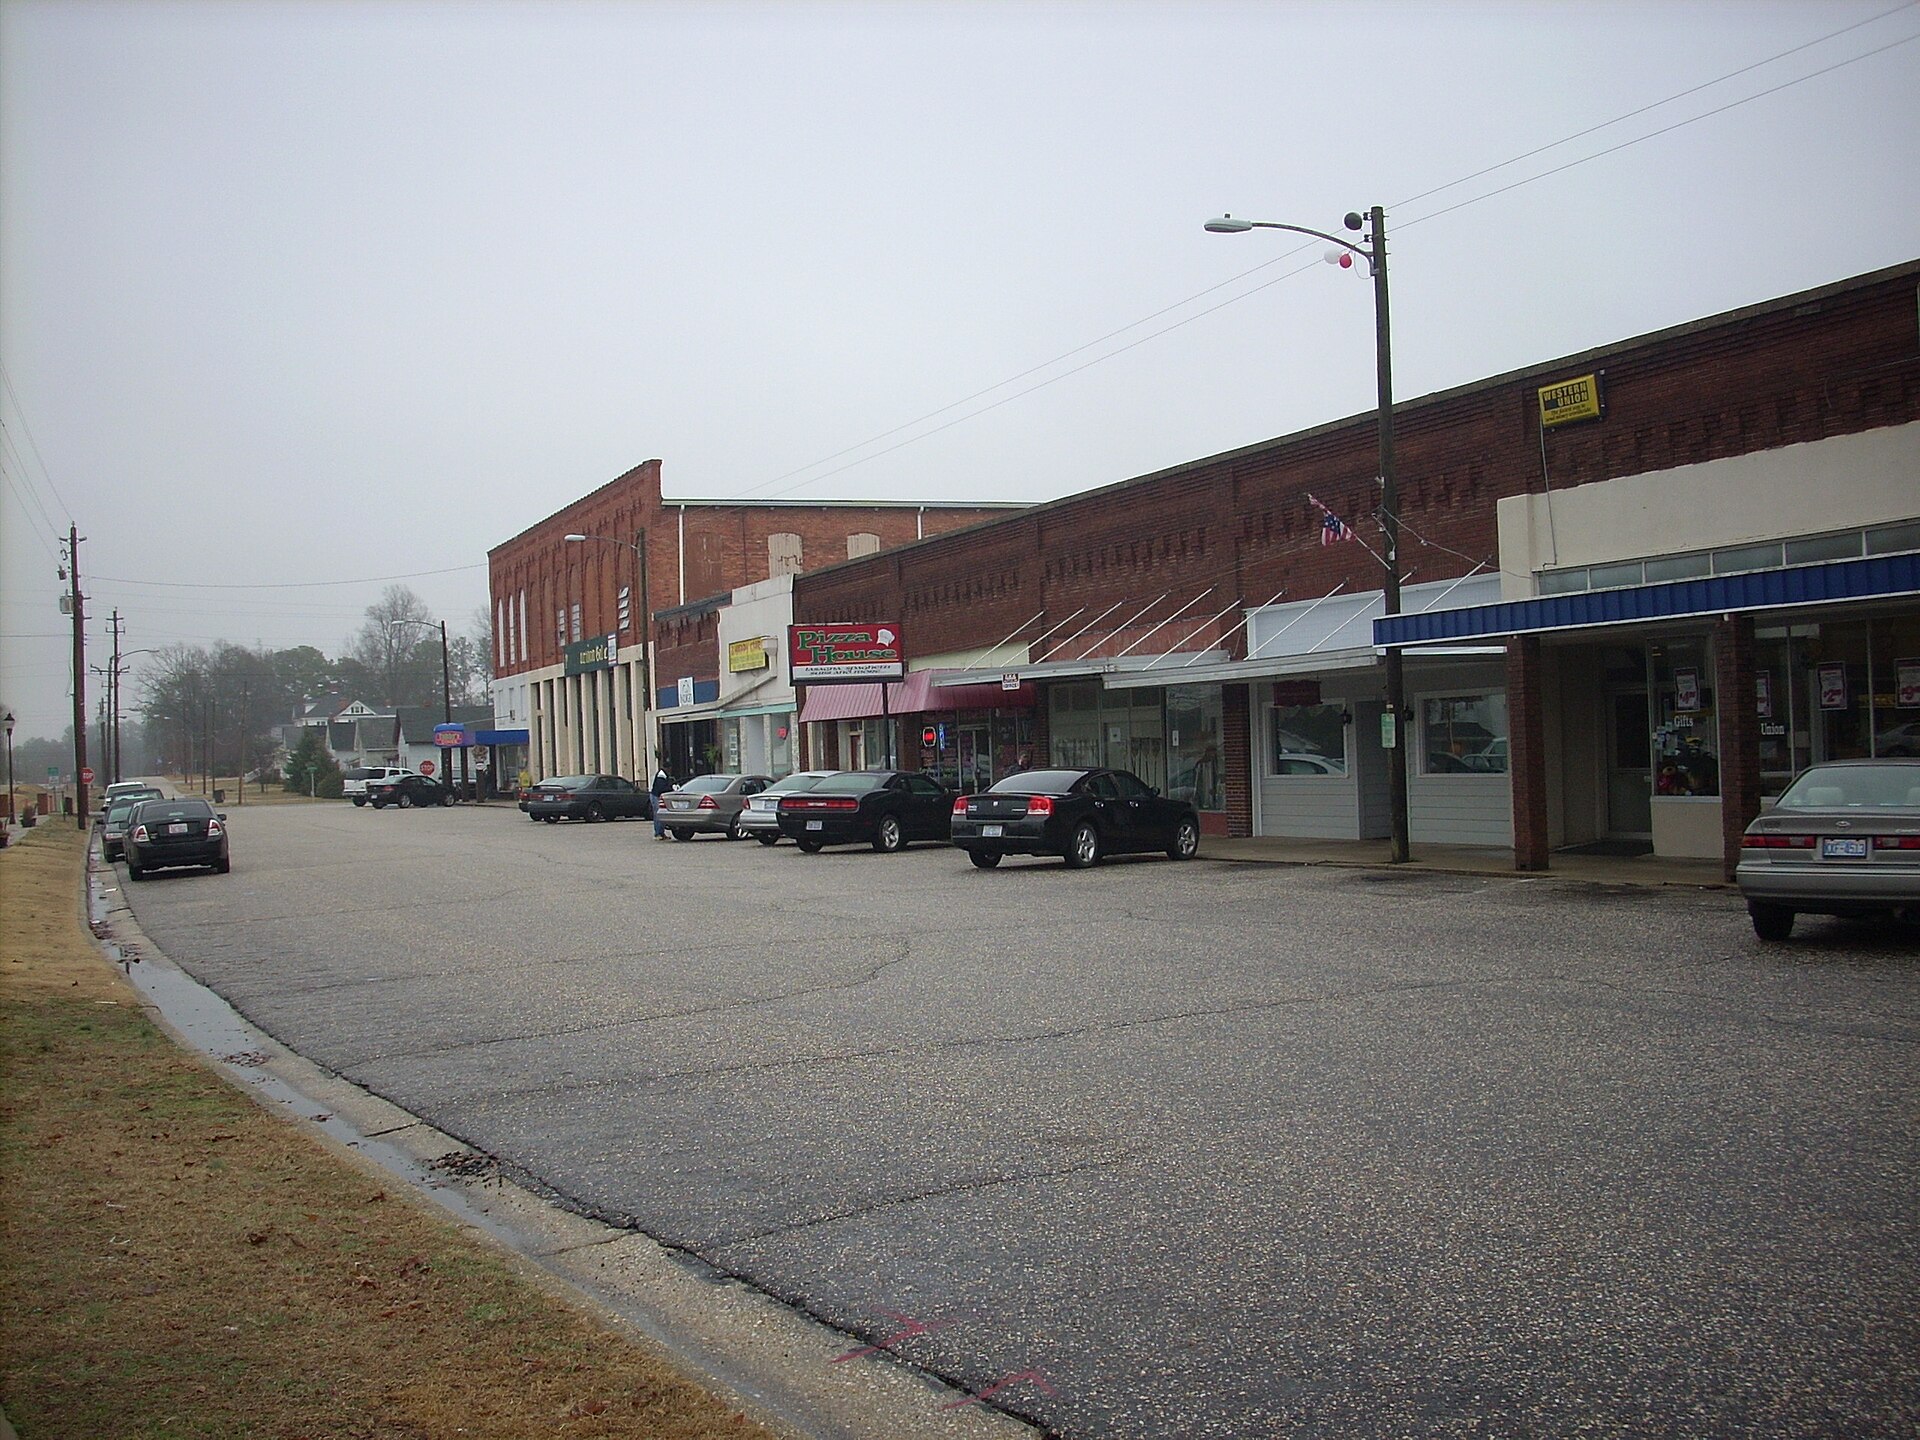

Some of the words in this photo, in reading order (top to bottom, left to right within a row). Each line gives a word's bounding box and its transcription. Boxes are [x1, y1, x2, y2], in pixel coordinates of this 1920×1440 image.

[1543, 382, 1587, 401] WESTERN
[1557, 391, 1588, 407] UNION
[797, 630, 872, 649] Pizza
[810, 645, 897, 665] House
[1674, 715, 1694, 727] Gifts
[1760, 722, 1785, 735] Union
